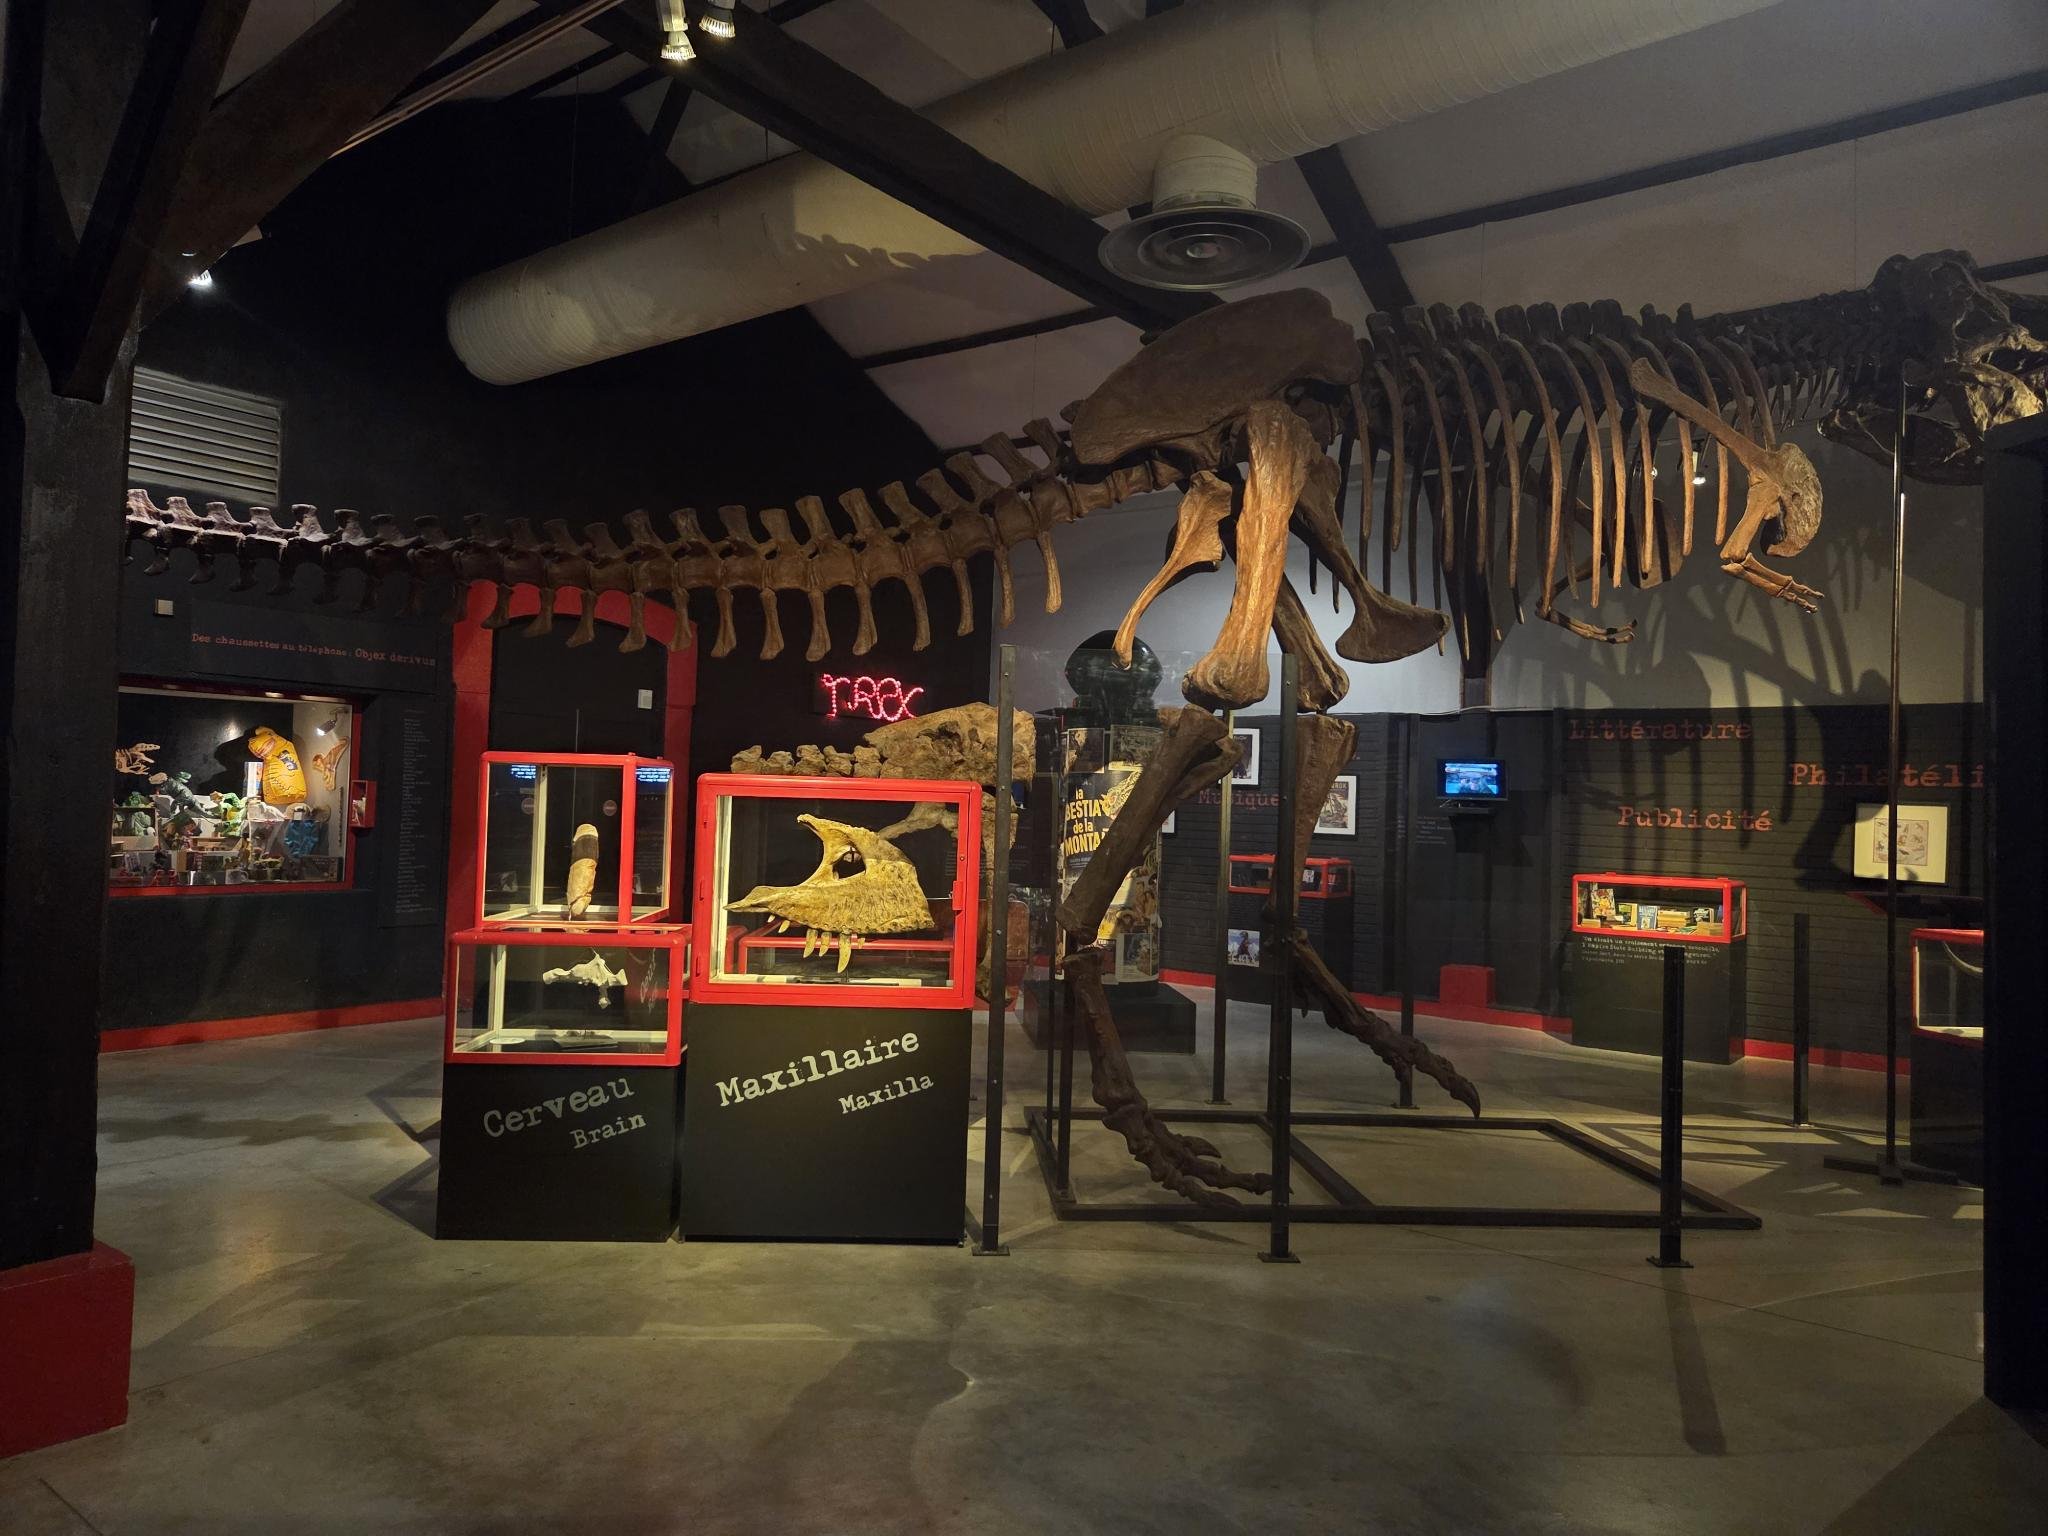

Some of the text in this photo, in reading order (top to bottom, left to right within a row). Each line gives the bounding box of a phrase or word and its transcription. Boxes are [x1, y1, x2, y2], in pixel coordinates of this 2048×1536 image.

[1568, 718, 1752, 741] Littérature
[1075, 786, 1084, 800] la
[1199, 788, 1281, 810] Muique
[1065, 799, 1102, 821] BESTIA
[1617, 805, 1773, 832] Publicité
[1072, 817, 1094, 834] de la
[715, 1032, 920, 1106] Maxillaire
[483, 1077, 635, 1138] Cerveau
[838, 1075, 934, 1115] Maxilla
[569, 1114, 647, 1149] Brain
